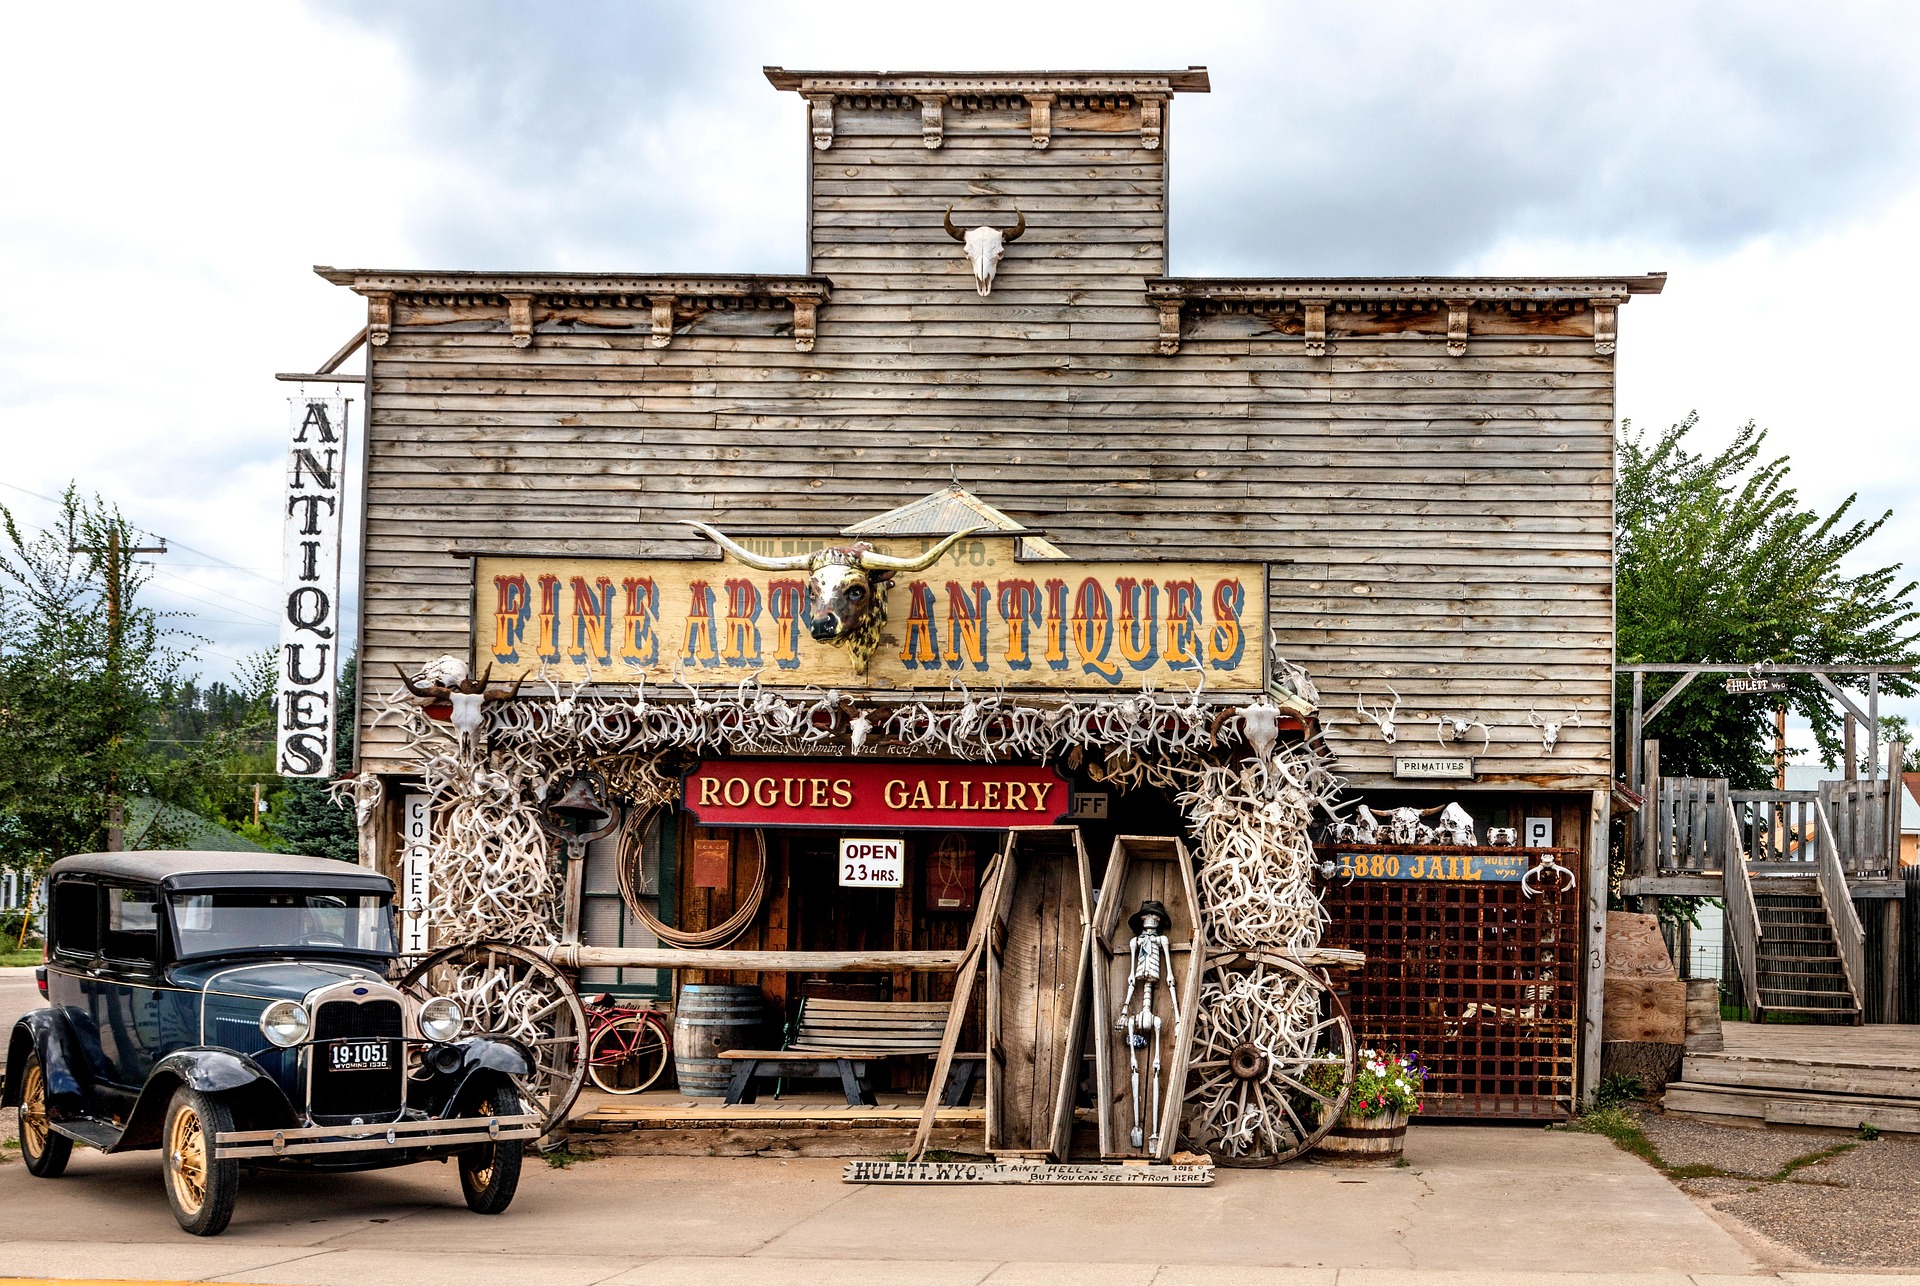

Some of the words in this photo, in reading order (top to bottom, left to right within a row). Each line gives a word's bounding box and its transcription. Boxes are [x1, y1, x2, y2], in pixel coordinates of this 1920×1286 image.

[282, 402, 338, 775] ANTIQUES
[491, 573, 660, 668] FINE
[678, 577, 812, 669] ART
[899, 577, 1246, 686] ANTIQUES
[1732, 680, 1768, 691] HULETT
[1404, 762, 1464, 771] PRIMATIVES
[698, 777, 853, 808] ROGUES
[884, 779, 1053, 811] GALLERY
[846, 844, 897, 860] OPEN
[1340, 855, 1400, 878] 1880
[1409, 856, 1482, 881] JAIL
[1484, 857, 1524, 867] HULETT
[845, 864, 868, 881] 23
[871, 869, 898, 882] HRS.
[1590, 950, 1601, 969] 3
[1031, 1173, 1052, 1181] BUT
[1102, 1174, 1122, 1182] SEE
[1047, 1165, 1083, 1174] HELL
